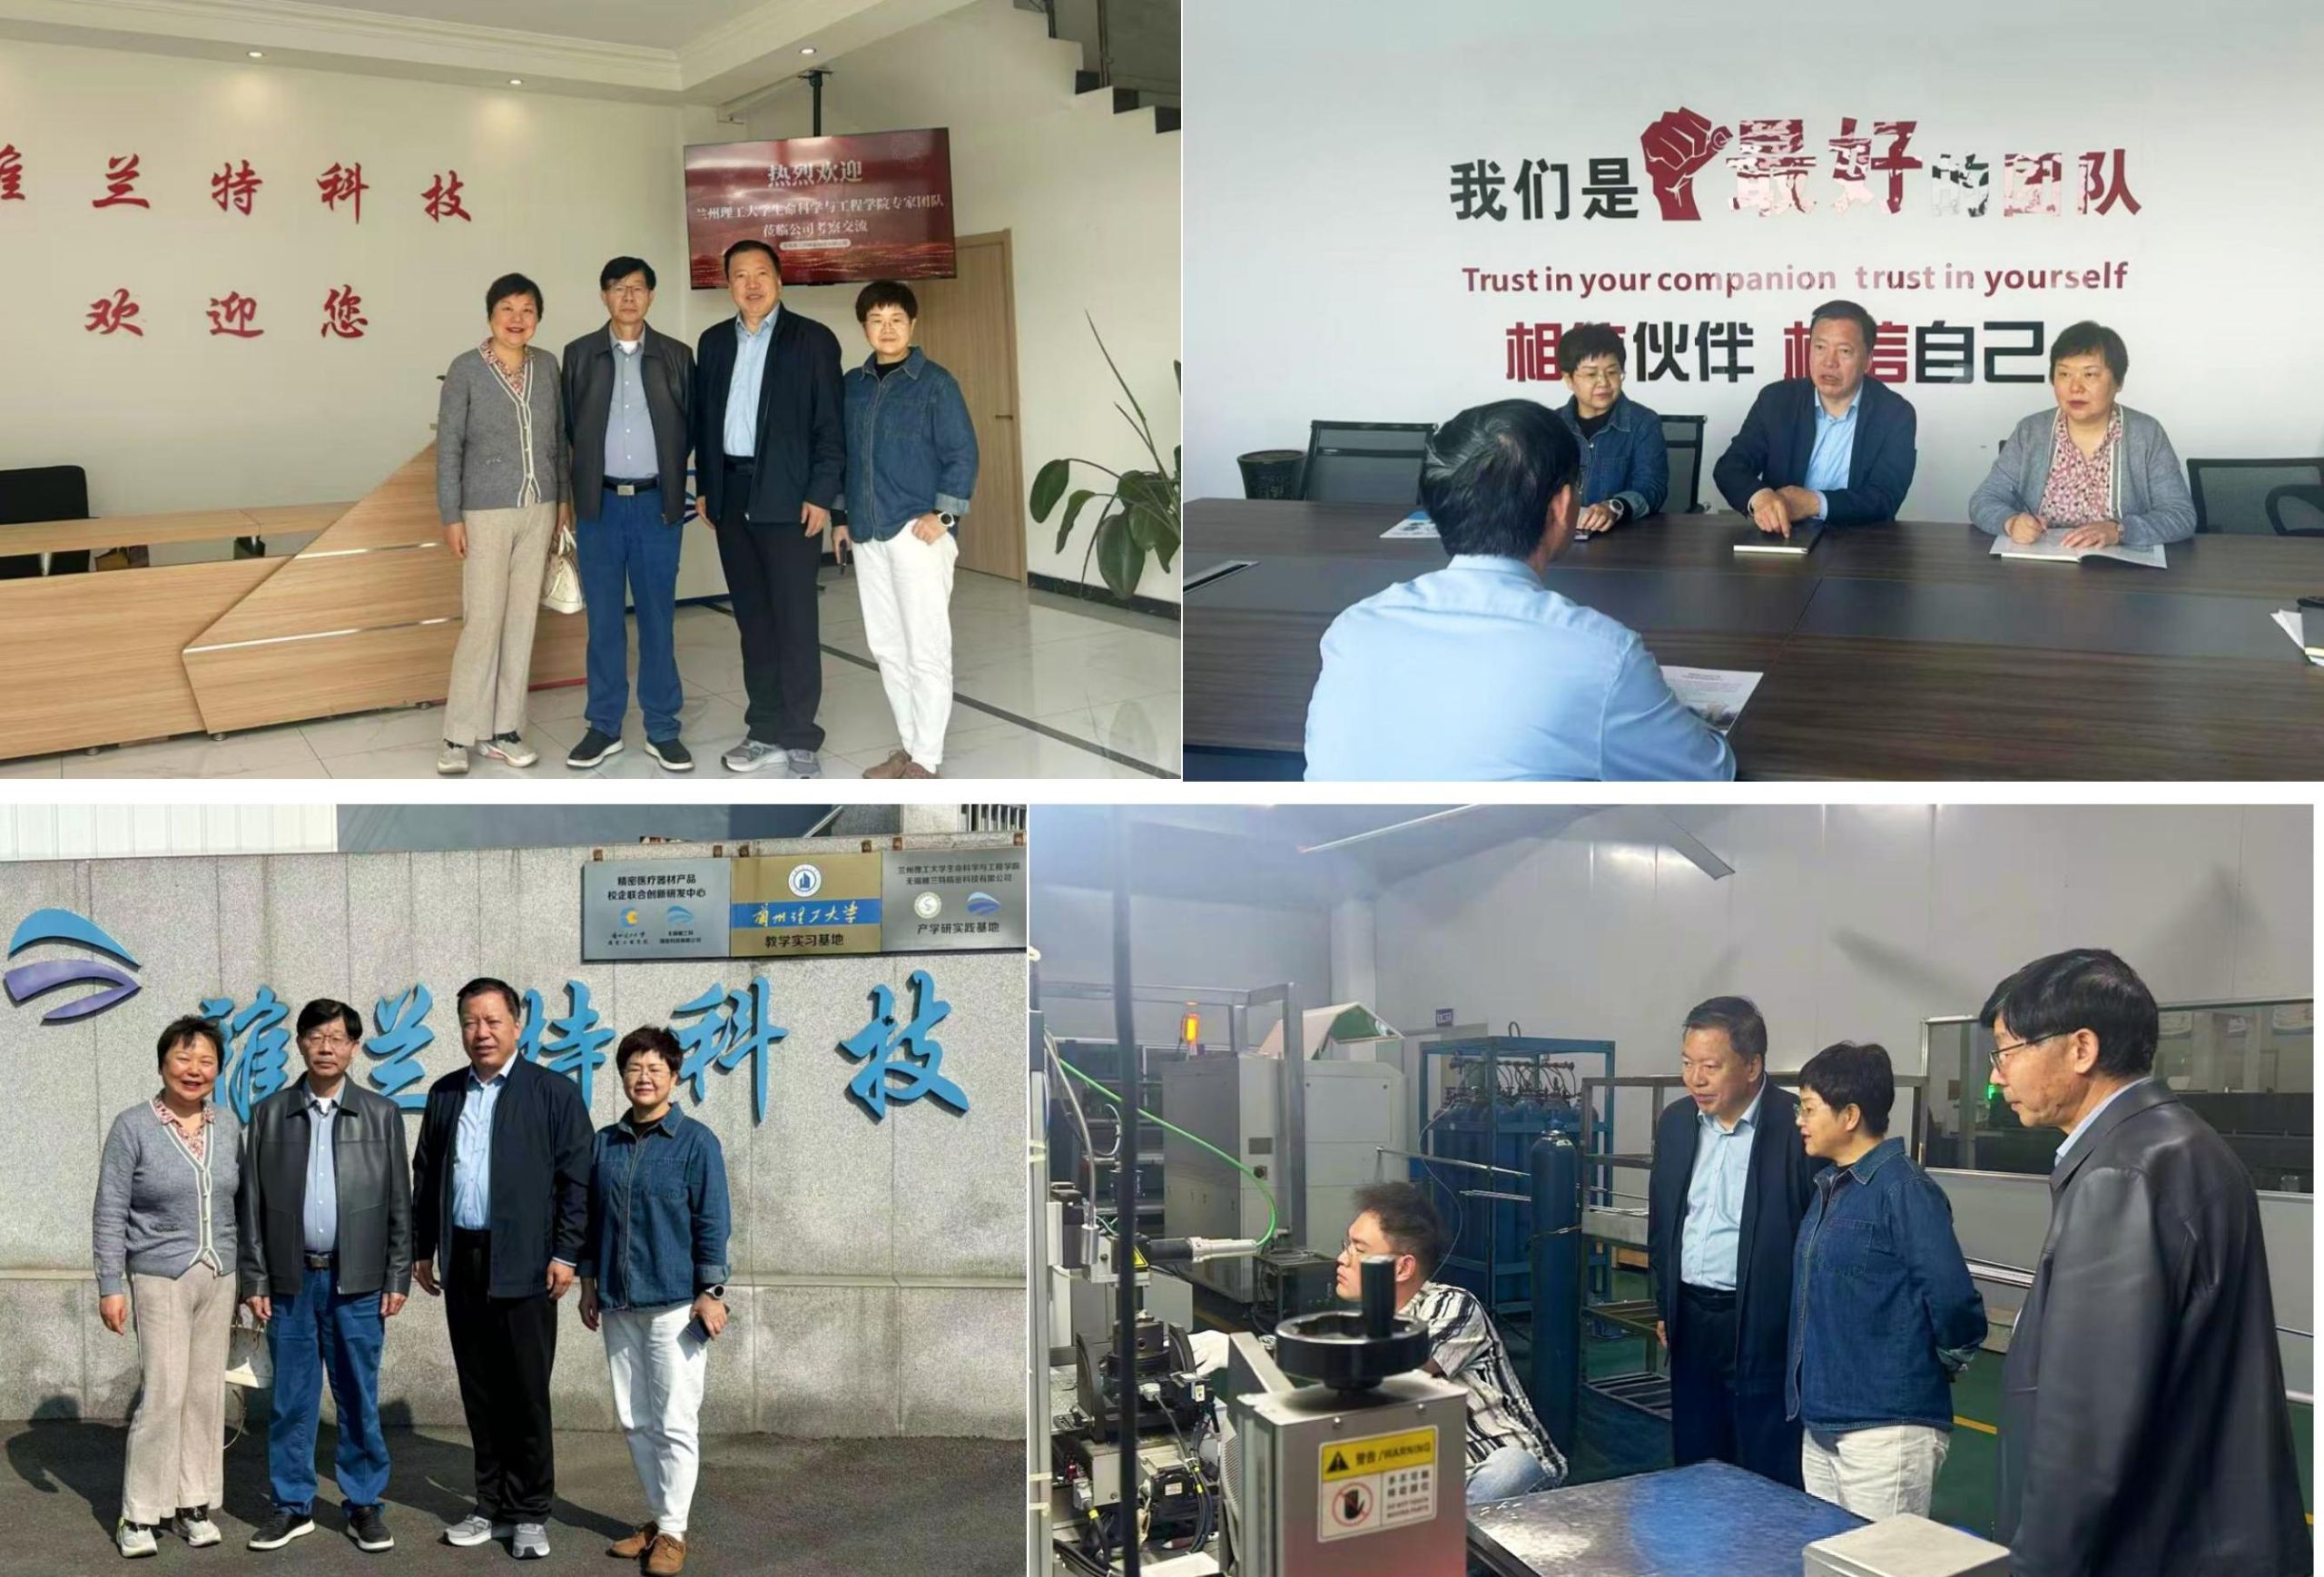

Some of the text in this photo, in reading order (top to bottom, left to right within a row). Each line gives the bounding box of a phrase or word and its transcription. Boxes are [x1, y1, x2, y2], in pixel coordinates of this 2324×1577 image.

[768, 159, 863, 189] 热烈欢迎
[1450, 117, 2142, 222] 我们是 最好的团队
[763, 219, 869, 239] 莅临公司考察交流
[1462, 261, 2128, 298] Trust in your companion trust in yourself
[84, 283, 369, 340] 欢迎您
[618, 873, 696, 886] 精密医疗器材产品
[607, 888, 706, 901] 校企联合创新研发中心
[917, 922, 1000, 935] 产学研实践基地
[765, 932, 844, 948] 教学实习基地
